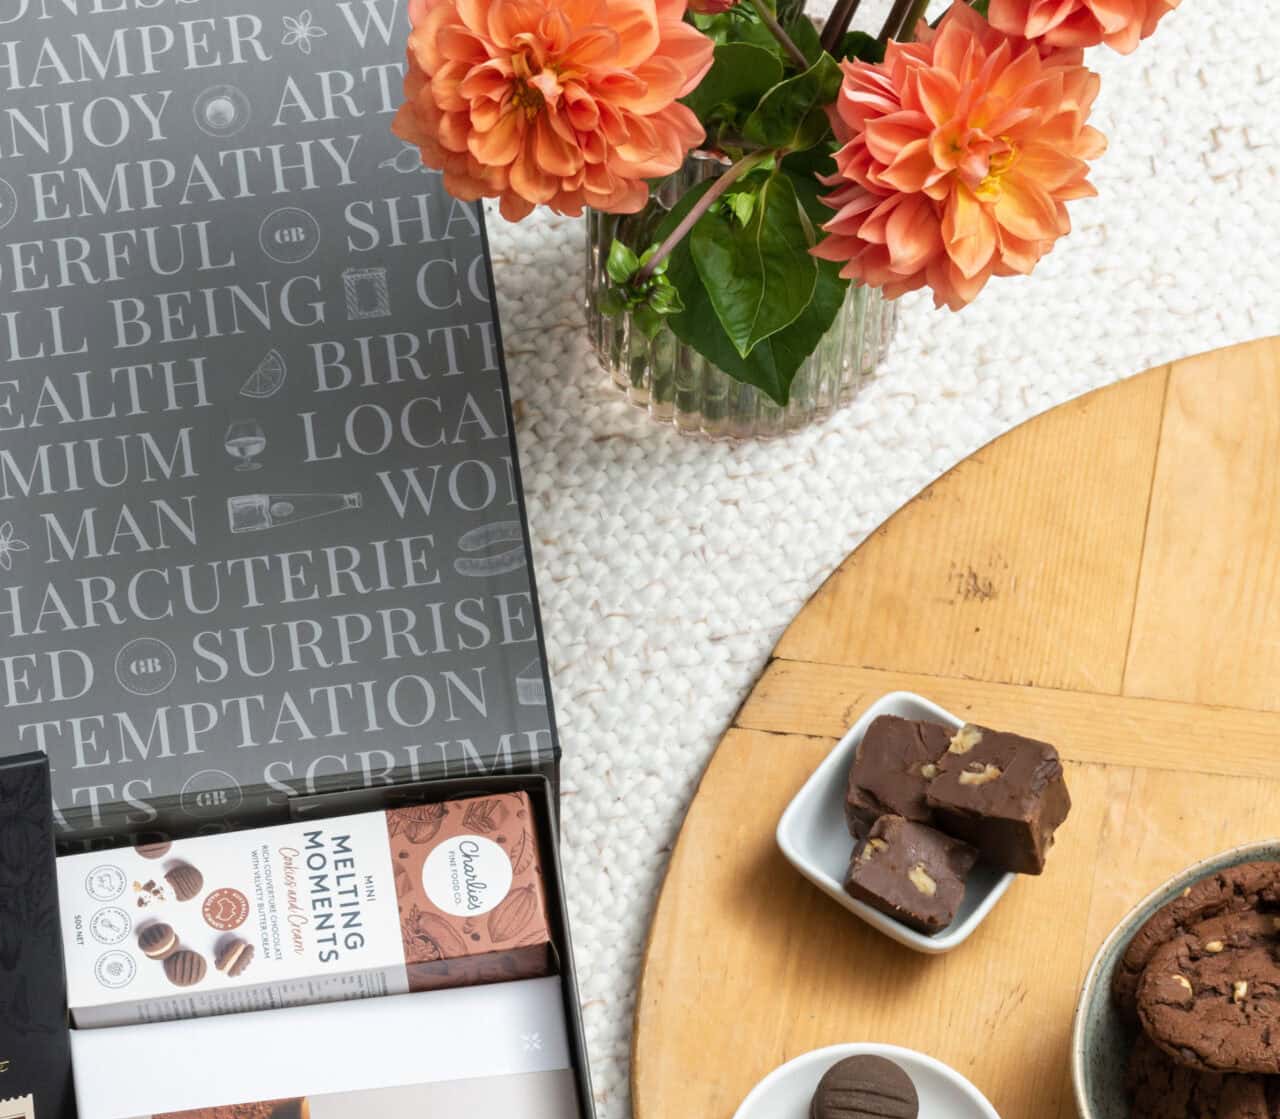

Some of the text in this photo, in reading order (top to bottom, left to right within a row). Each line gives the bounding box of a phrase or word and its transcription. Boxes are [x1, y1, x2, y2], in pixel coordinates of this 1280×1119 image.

[272, 62, 404, 127] ART
[28, 134, 363, 223] EMPATHY
[108, 275, 327, 350] BEING
[297, 388, 510, 463] LOCA
[40, 494, 200, 564] MAN
[192, 591, 538, 684] SURPRISE
[18, 666, 489, 776] TEMPTATION
[252, 850, 270, 959] WITH VELVETY BUTTER CREAM
[278, 847, 309, 955] Cookies and Cream
[303, 830, 340, 963] MOMENTS
[331, 834, 366, 951] MELTING
[364, 875, 377, 902] MINI
[459, 840, 487, 911] Charlie's
[270, 914, 283, 960] CHOCOLATE
